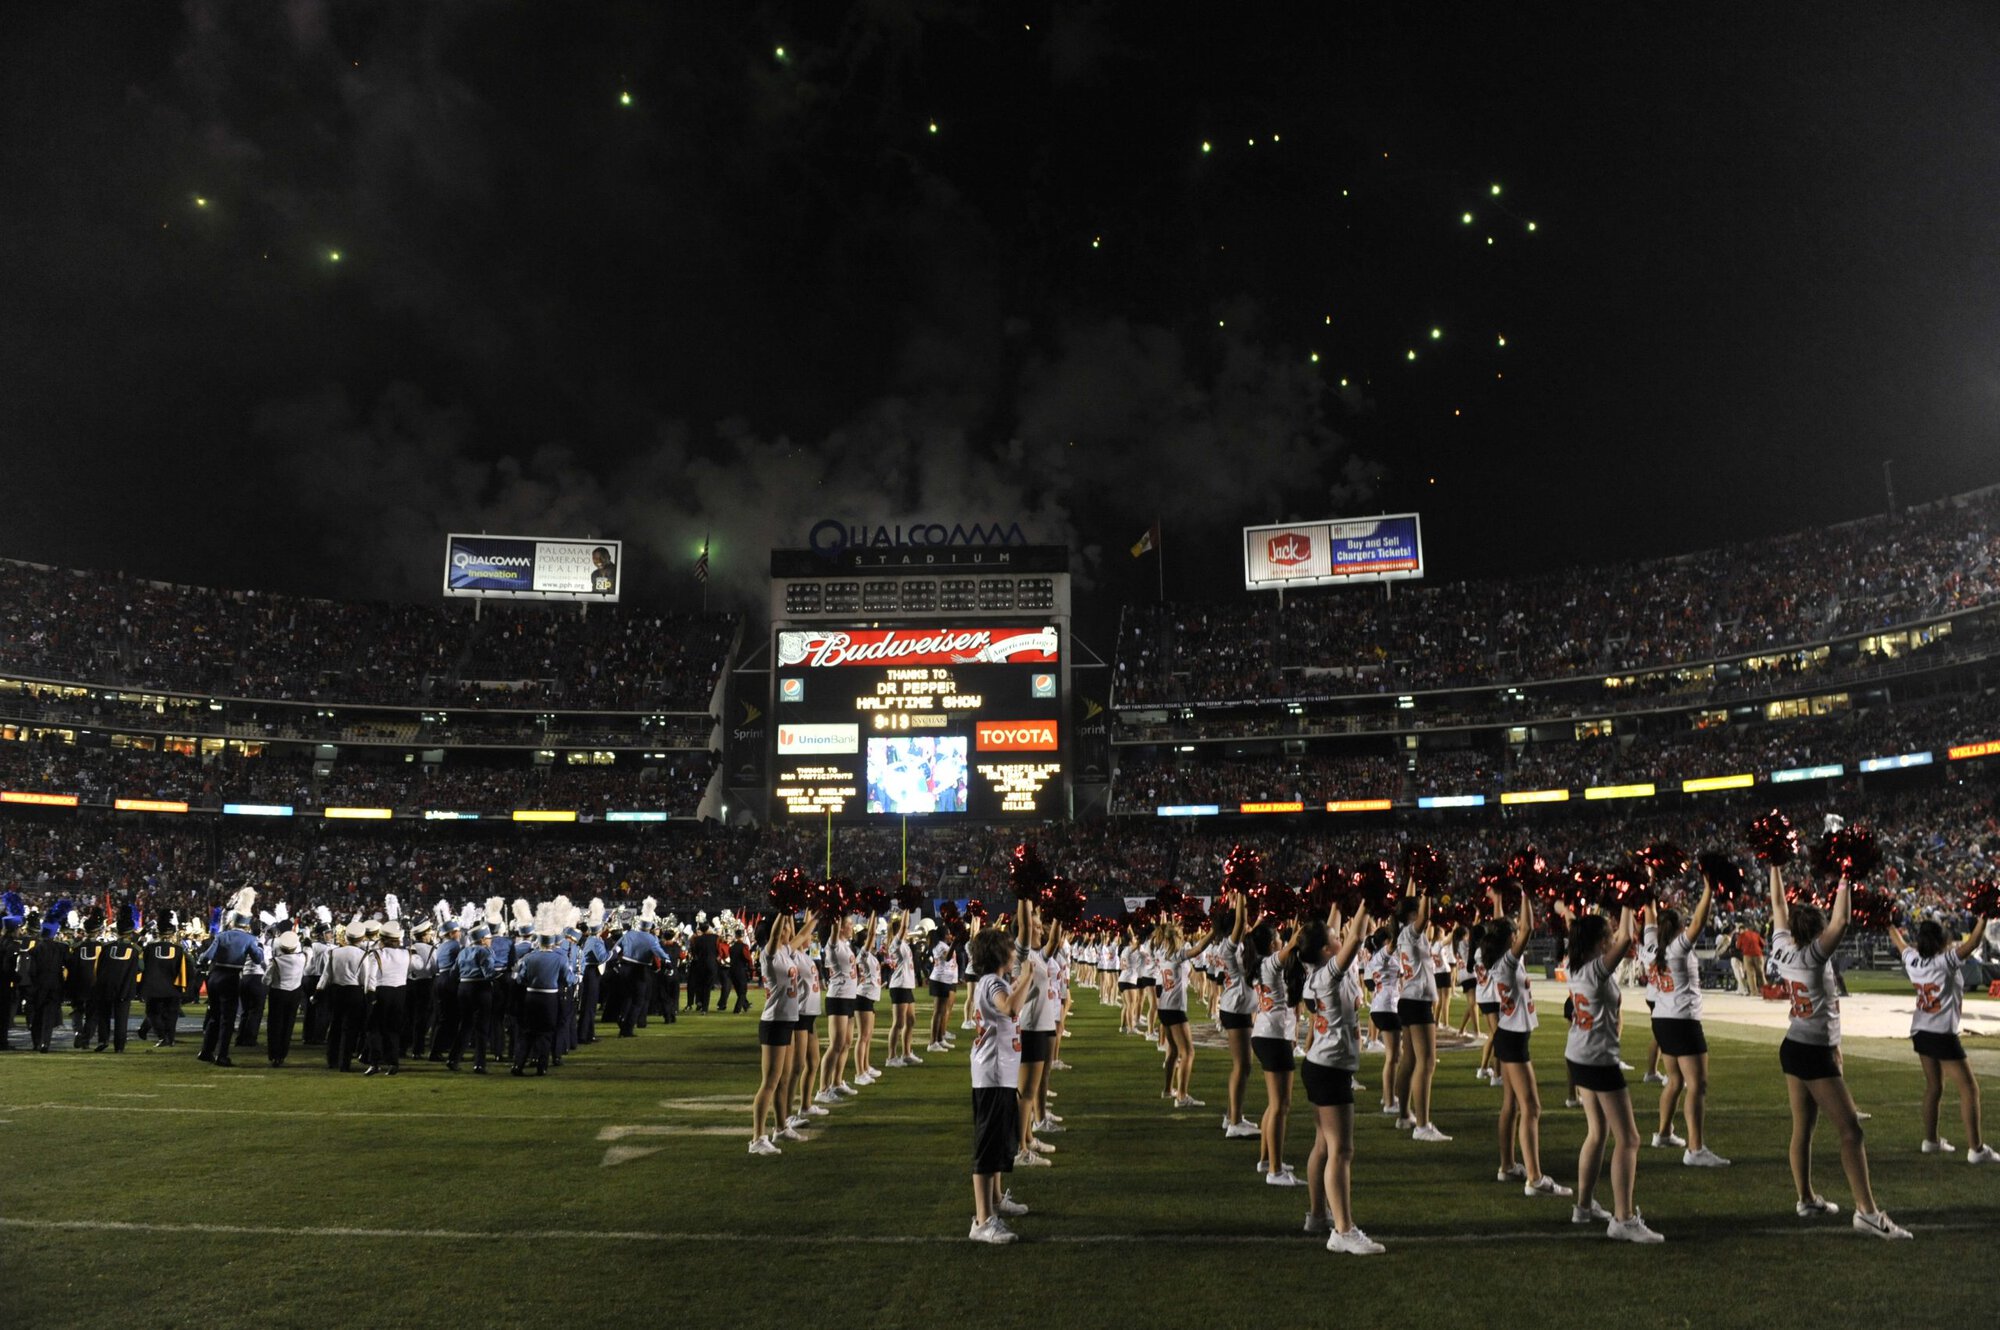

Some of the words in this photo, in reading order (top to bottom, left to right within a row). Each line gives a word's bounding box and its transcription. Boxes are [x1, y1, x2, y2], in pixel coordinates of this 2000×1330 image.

[809, 519, 1027, 559] QUALCOMM
[1347, 540, 1363, 550] Buy
[1365, 538, 1381, 548] and
[1383, 536, 1399, 547] Sell
[539, 547, 591, 556] PALOMAR
[1270, 536, 1309, 562] Jack
[1337, 550, 1376, 562] Chargers
[1377, 546, 1412, 559] Tickets!
[454, 552, 531, 570] QUALCOMM
[538, 555, 590, 565] POMERADO
[855, 553, 1010, 565] STADIUM
[468, 569, 518, 579] Innovation
[538, 564, 590, 573] HEALTH
[542, 581, 585, 590] www.pph.org
[804, 629, 991, 667] Budweiser
[887, 669, 928, 680] THANKS
[932, 668, 948, 680] TO
[877, 682, 897, 695] DR
[903, 681, 957, 695] PEPPER
[856, 697, 934, 709] HALFTIME
[942, 695, 982, 709] SHOW
[733, 729, 764, 741] Sprint
[980, 728, 1054, 744] TOYOTA
[1243, 803, 1271, 813] WELLS
[1272, 802, 1302, 812] FARGO
[80, 946, 102, 960] U
[109, 946, 133, 961] U
[155, 946, 176, 960] U
